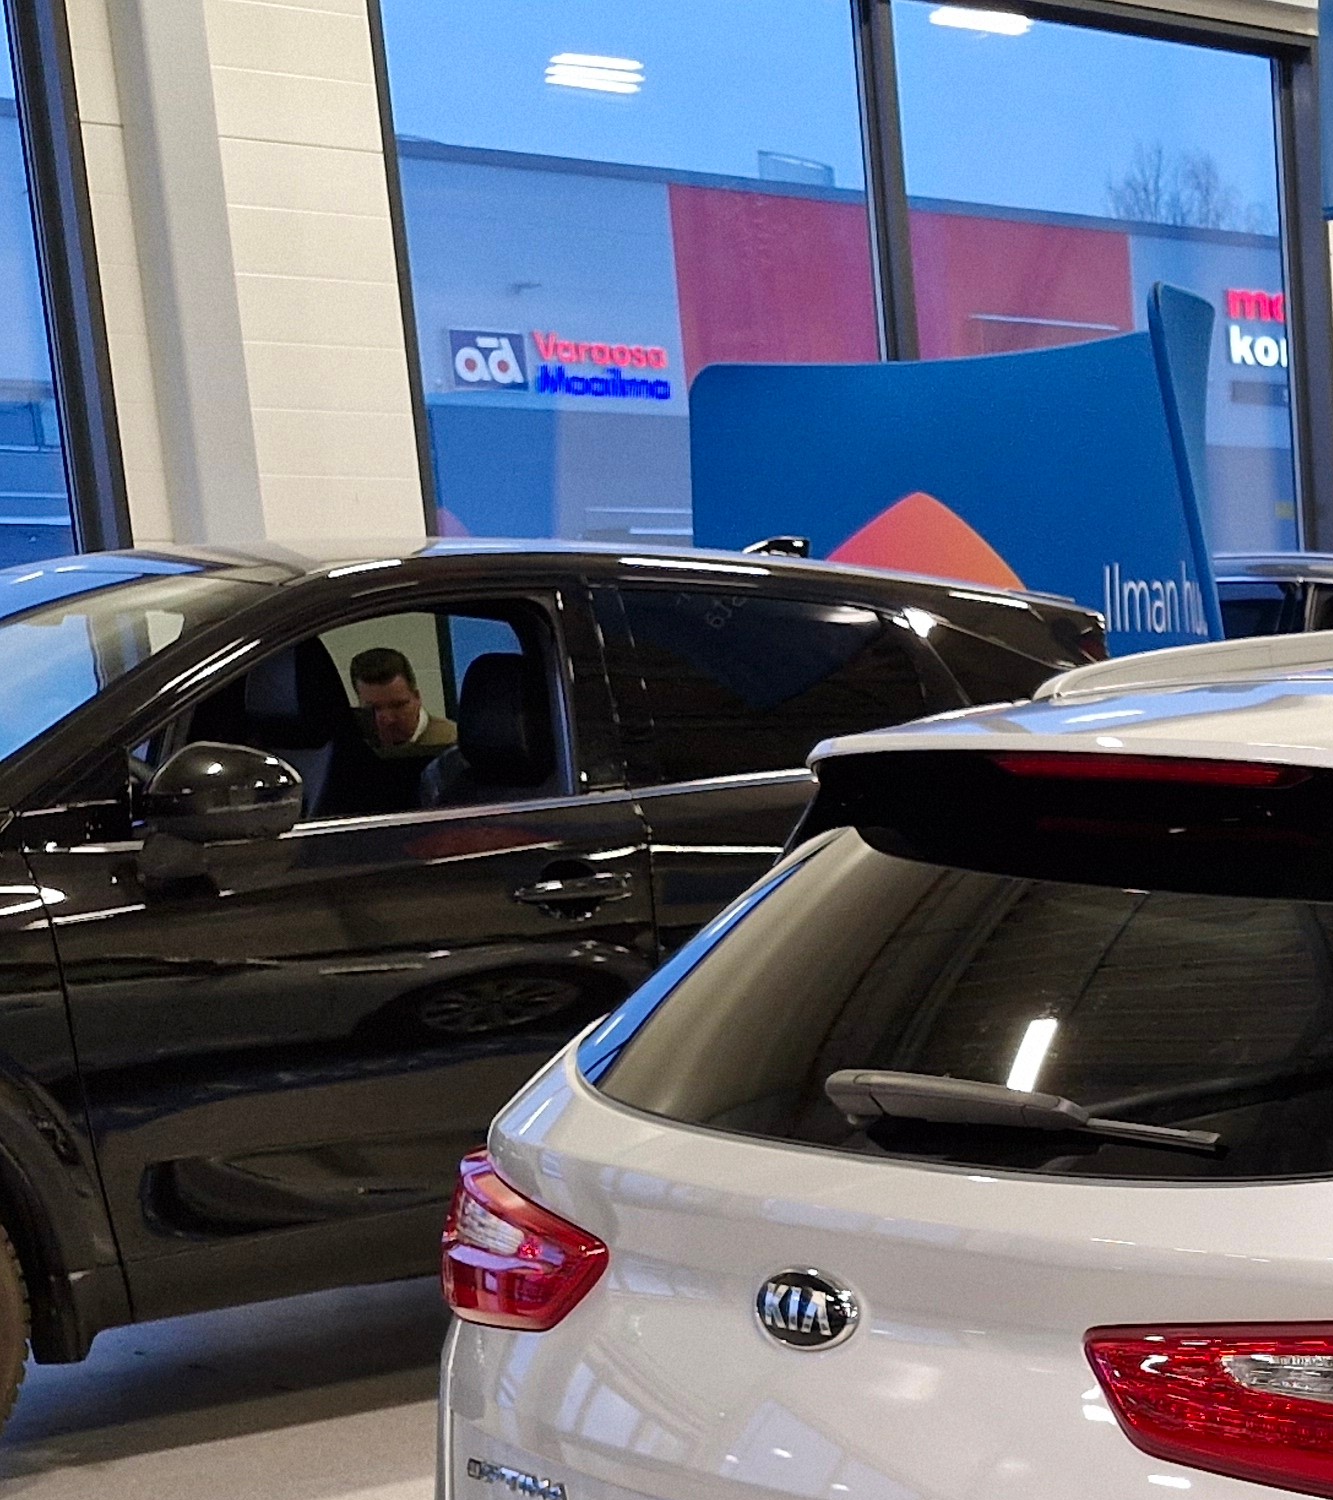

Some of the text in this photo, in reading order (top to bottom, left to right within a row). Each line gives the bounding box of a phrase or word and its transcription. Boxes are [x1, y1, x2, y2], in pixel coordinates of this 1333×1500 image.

[532, 330, 668, 369] Varaosa
[1104, 562, 1181, 634] Ilman
[764, 1281, 833, 1337] KIA
